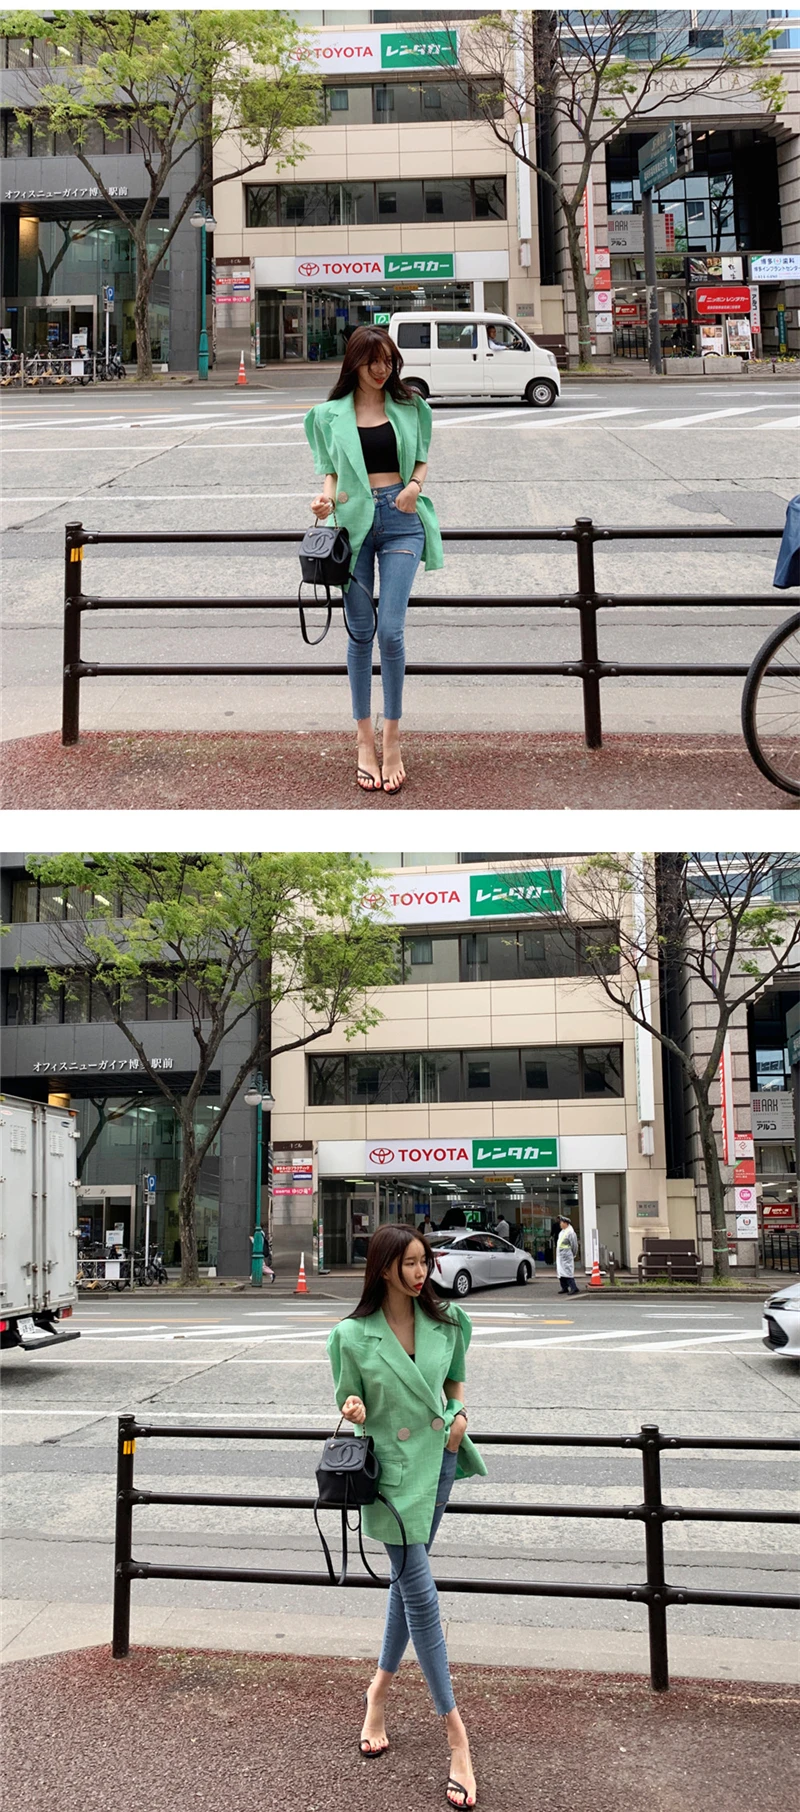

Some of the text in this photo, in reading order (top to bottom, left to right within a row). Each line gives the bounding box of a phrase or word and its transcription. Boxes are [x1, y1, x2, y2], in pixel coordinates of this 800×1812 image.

[313, 43, 452, 59] TOYOTA レンタカー
[322, 260, 450, 275] TOYOTA レンタカー
[389, 885, 555, 907] TOYOTA レンタカー
[761, 1098, 779, 1112] ARK
[756, 1123, 777, 1131] アルコ
[398, 1146, 553, 1162] TOYOTA レンタカー
